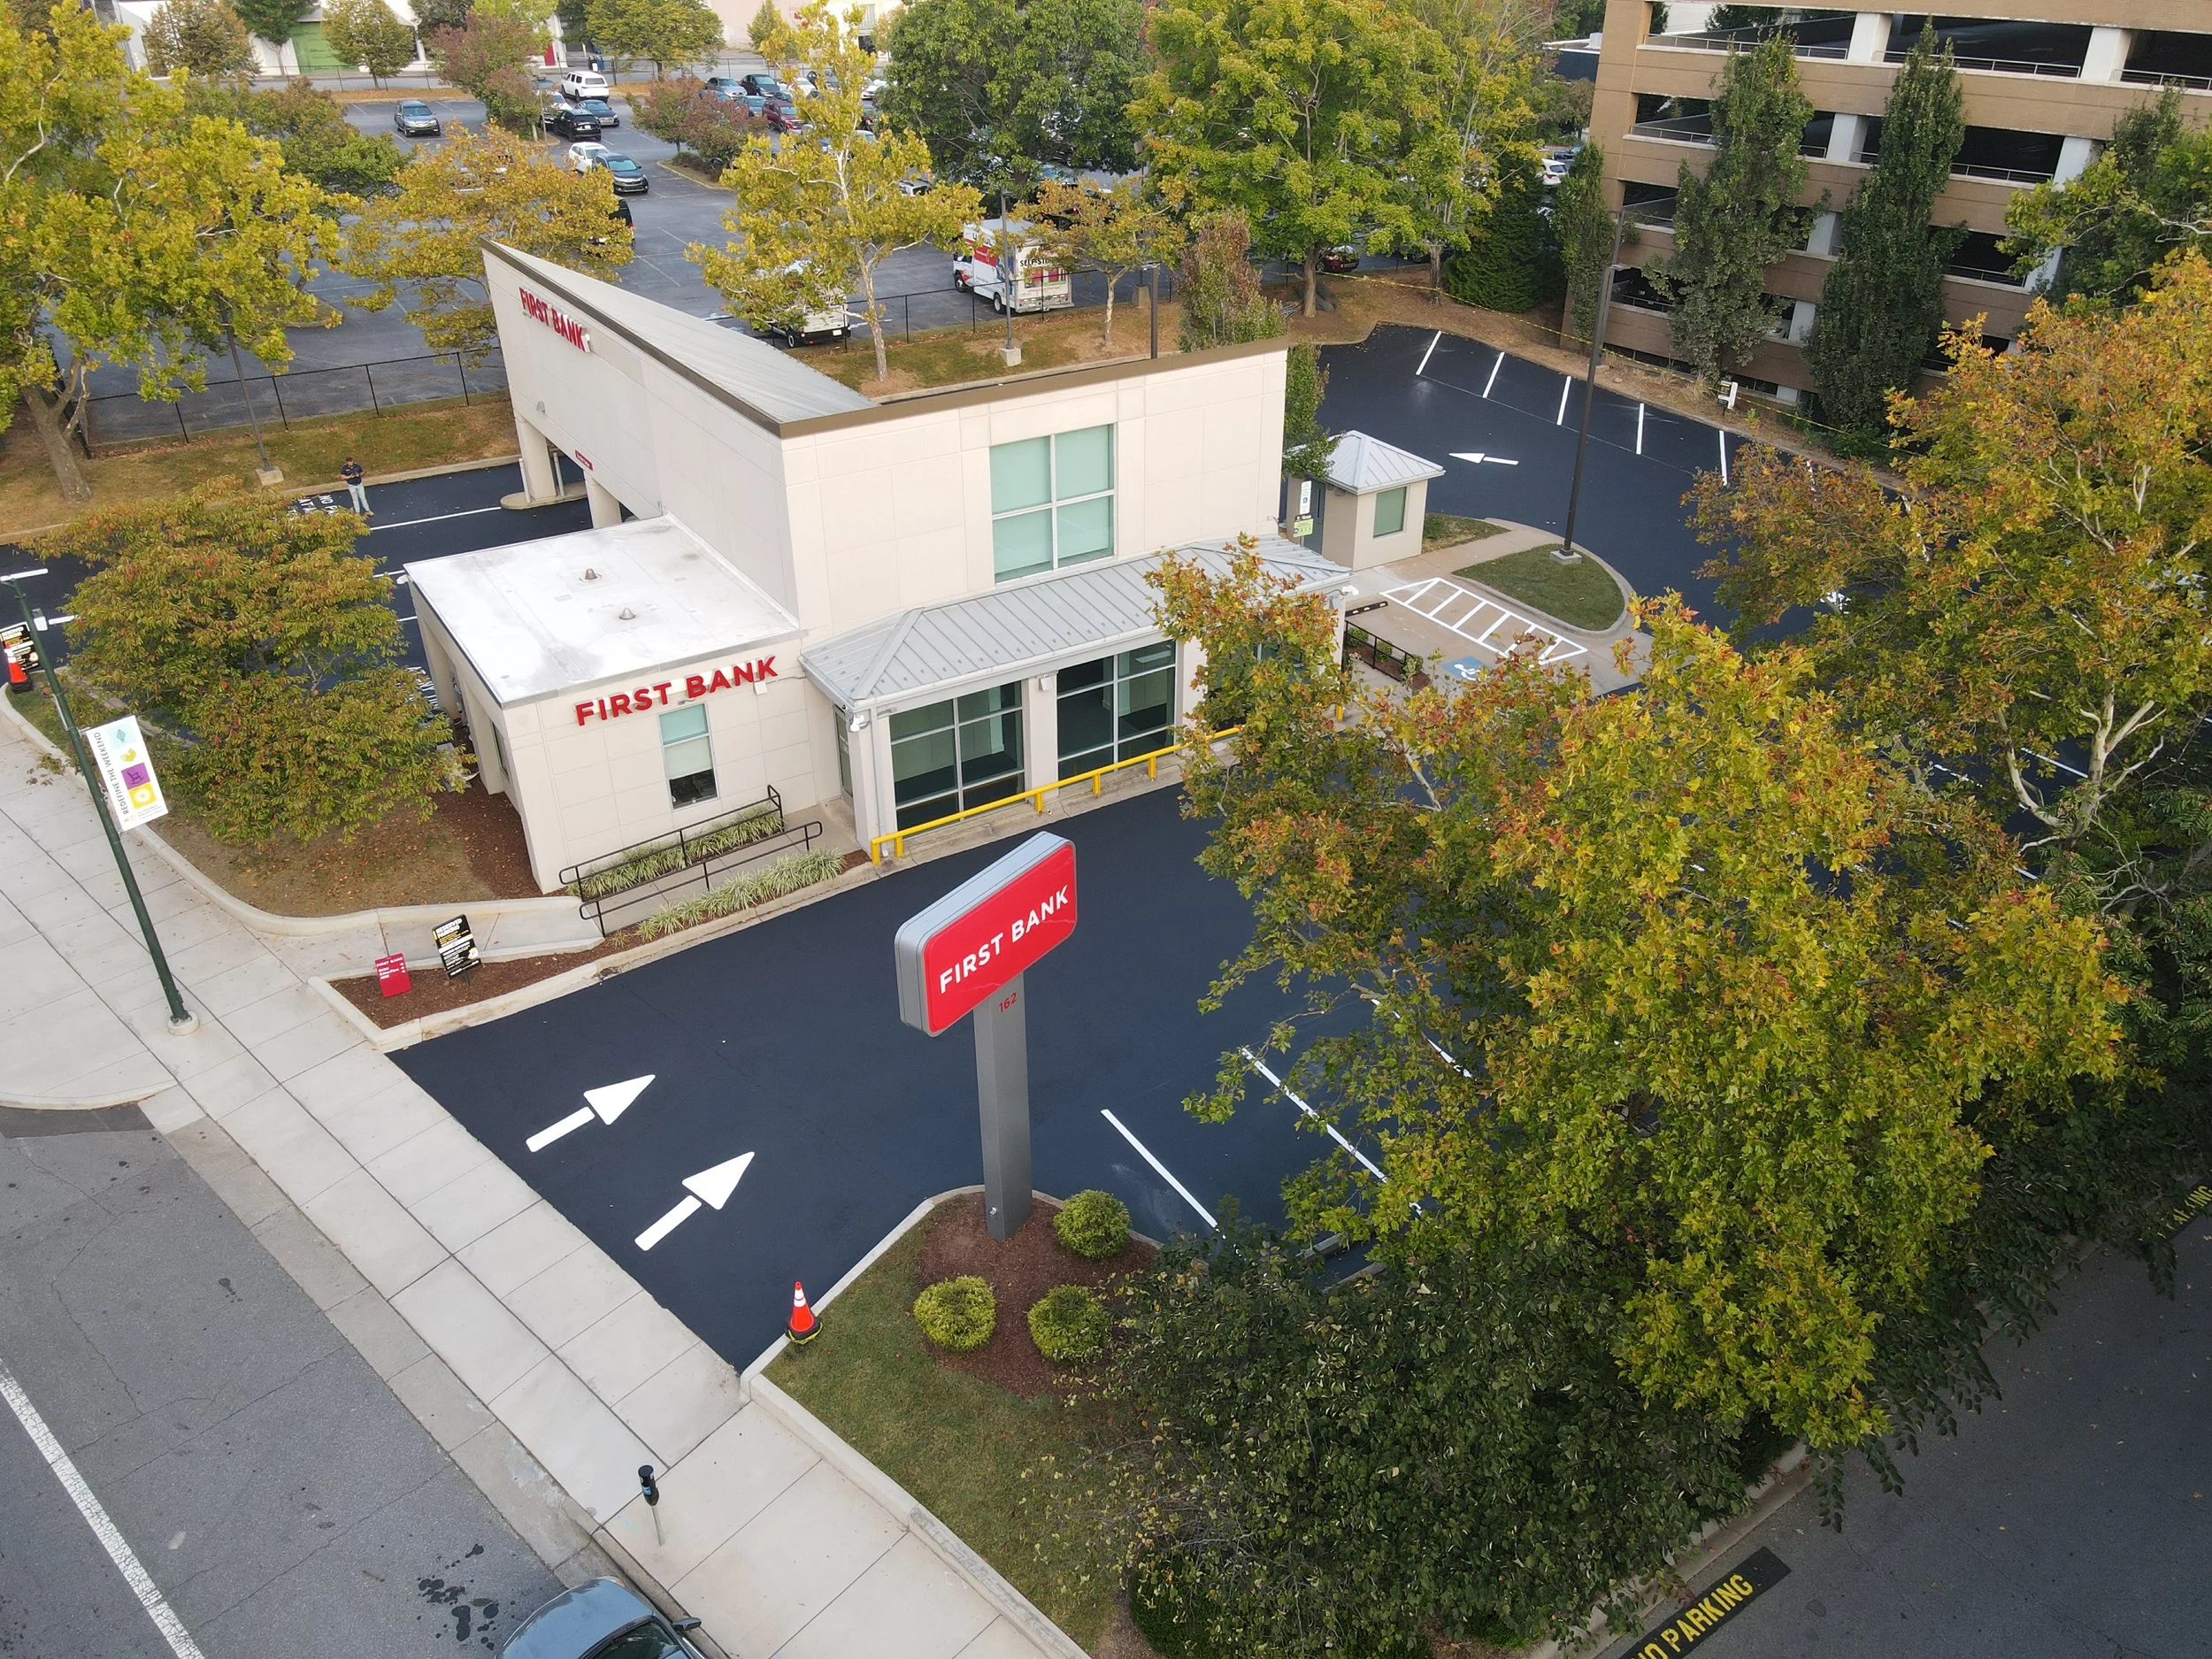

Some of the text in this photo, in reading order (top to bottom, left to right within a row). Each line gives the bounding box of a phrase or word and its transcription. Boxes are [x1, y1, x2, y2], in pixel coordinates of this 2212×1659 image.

[518, 286, 585, 352] FIRST BANK
[319, 495, 334, 504] NO
[575, 656, 778, 726] FIRST BANK
[94, 732, 129, 815] REDEFINE THE WEEKEND
[939, 885, 1069, 995] FIRST BANK
[998, 993, 1017, 1012] 162
[1660, 1574, 1754, 1652] PARKING
